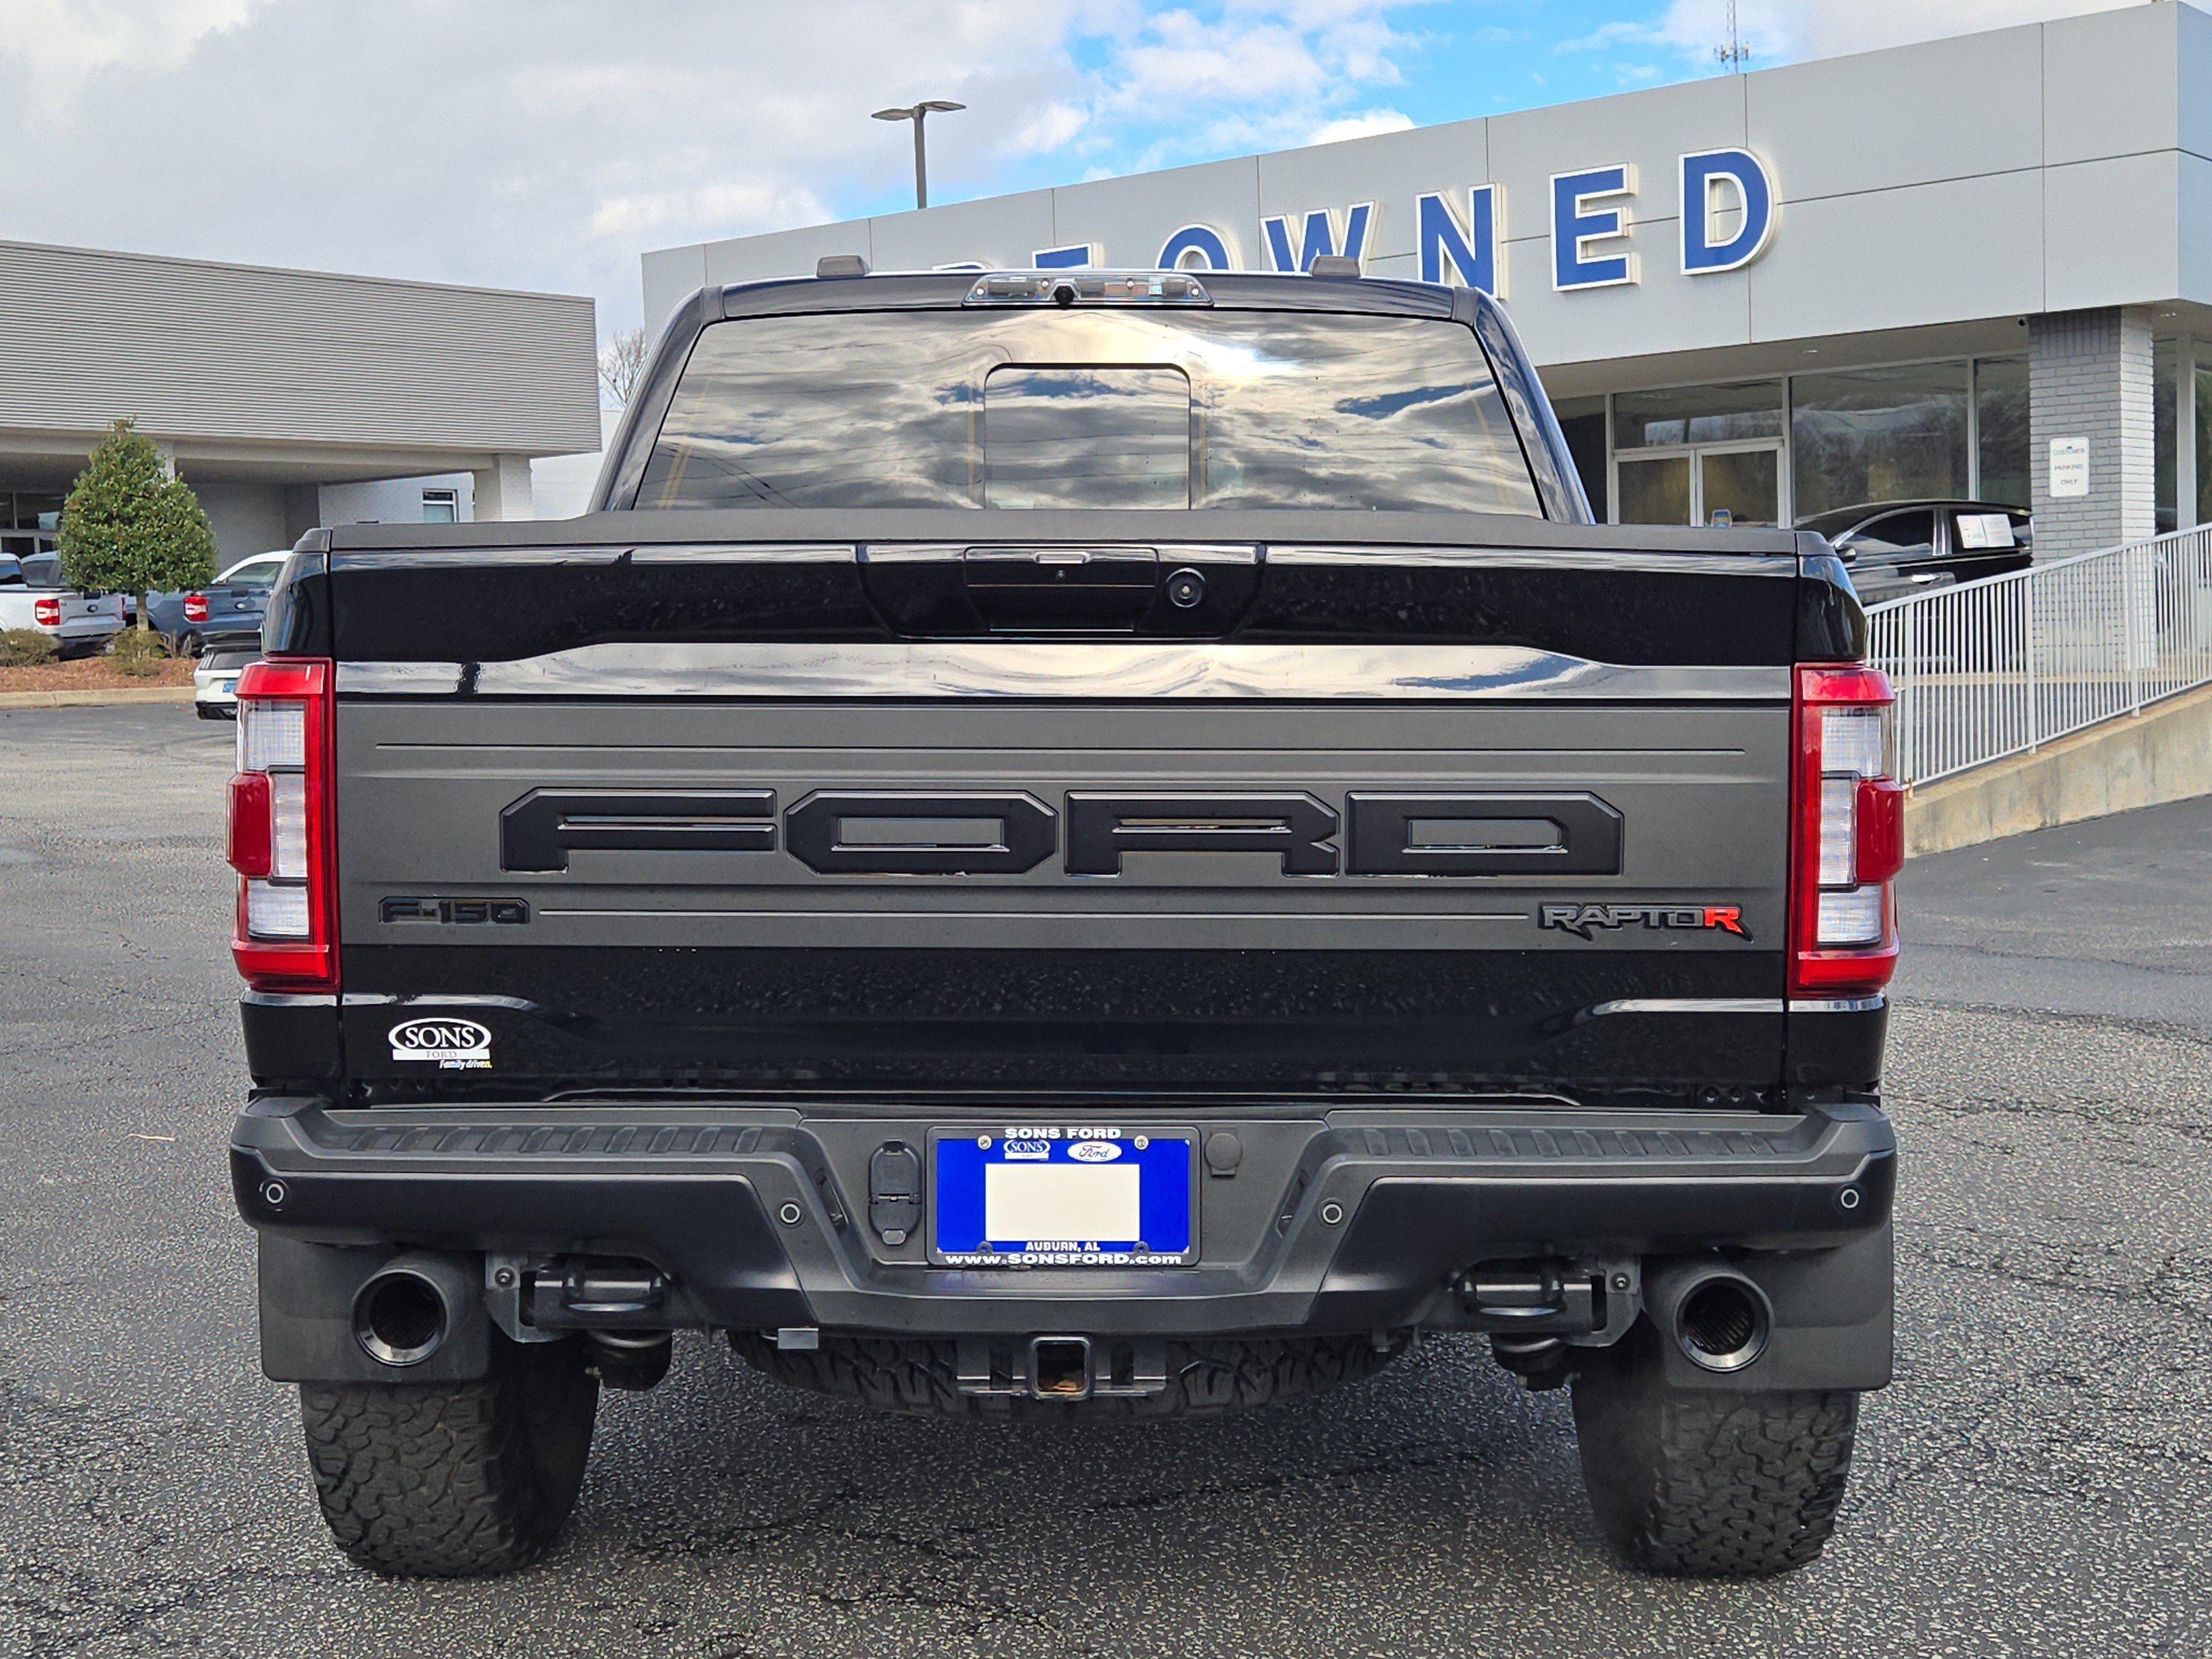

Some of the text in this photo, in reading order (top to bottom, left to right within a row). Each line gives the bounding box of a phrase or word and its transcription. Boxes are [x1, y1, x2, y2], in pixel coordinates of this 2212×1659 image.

[500, 787, 1624, 876] FORD
[378, 897, 530, 924] F-150
[1538, 902, 1754, 942] RAPTOR
[405, 1027, 475, 1047] SONS
[1005, 1128, 1121, 1139] SONS FORD
[1011, 1141, 1044, 1153] SONS
[1078, 1144, 1110, 1158] Ford
[1084, 1242, 1101, 1251] AL
[945, 1253, 1181, 1265] www.SONSFORD.com
